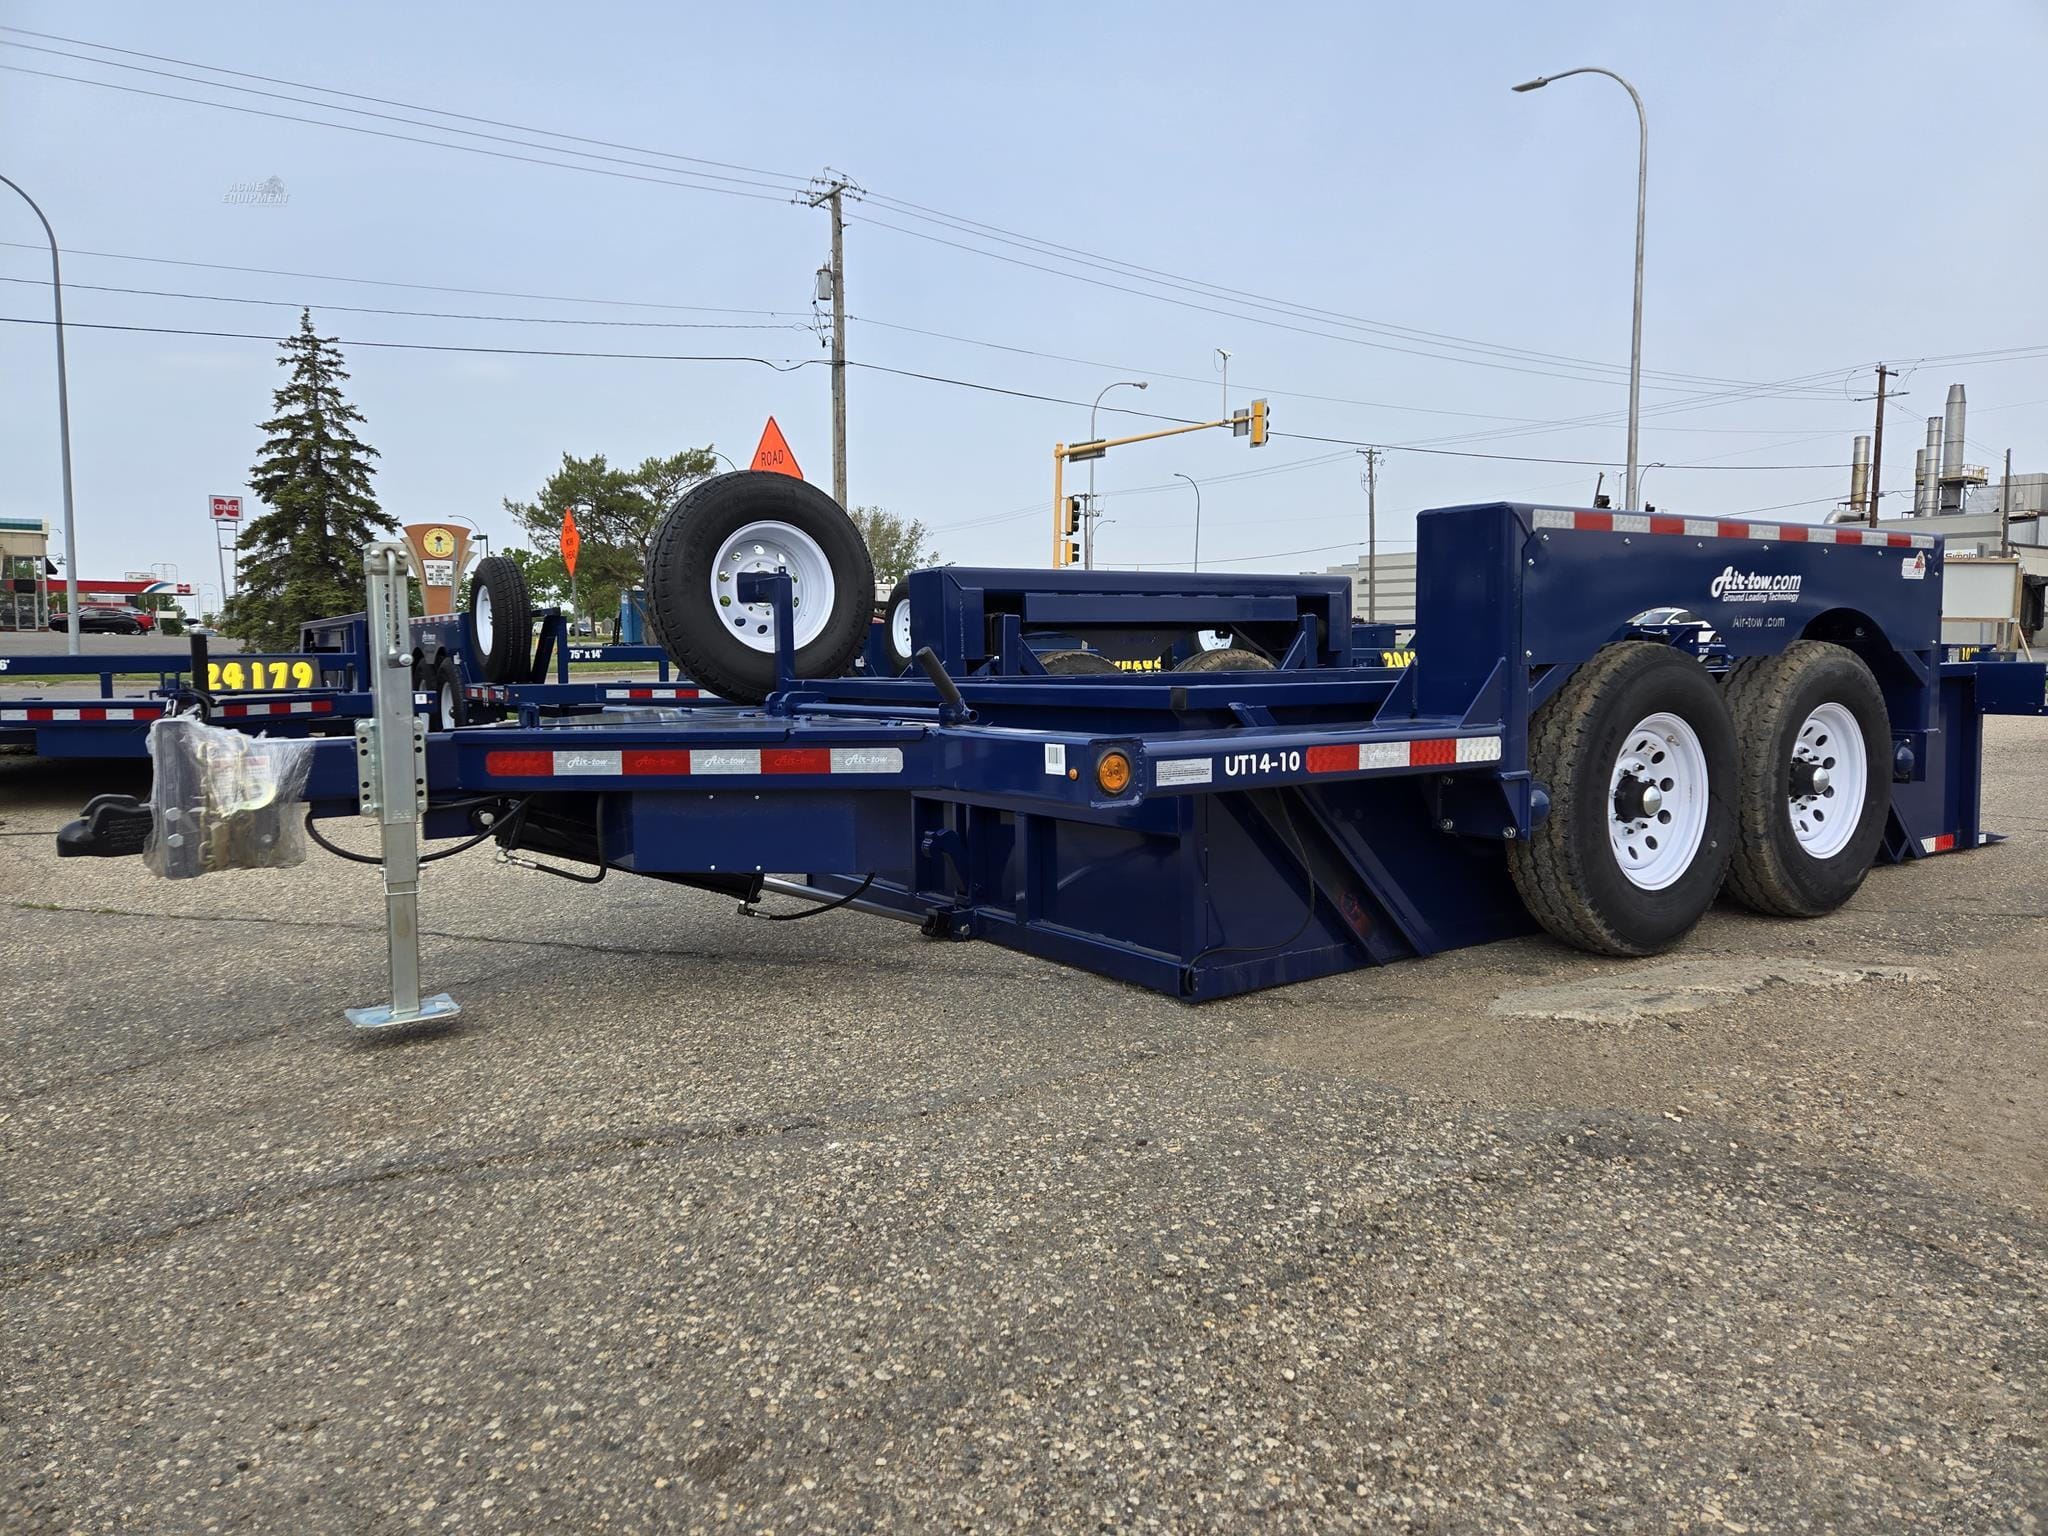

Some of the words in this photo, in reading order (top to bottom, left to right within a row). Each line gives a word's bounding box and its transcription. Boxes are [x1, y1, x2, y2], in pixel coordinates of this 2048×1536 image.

[761, 449, 784, 467] ROAD
[1711, 565, 1802, 598] Air-tow.com
[1722, 593, 1745, 602] Ground
[1745, 593, 1768, 603] Loading
[1768, 592, 1800, 603] Technology
[567, 755, 608, 768] Air-tow
[704, 755, 747, 768] Air-tow
[845, 753, 888, 766] Air-tow
[1224, 751, 1301, 777] UT14-10
